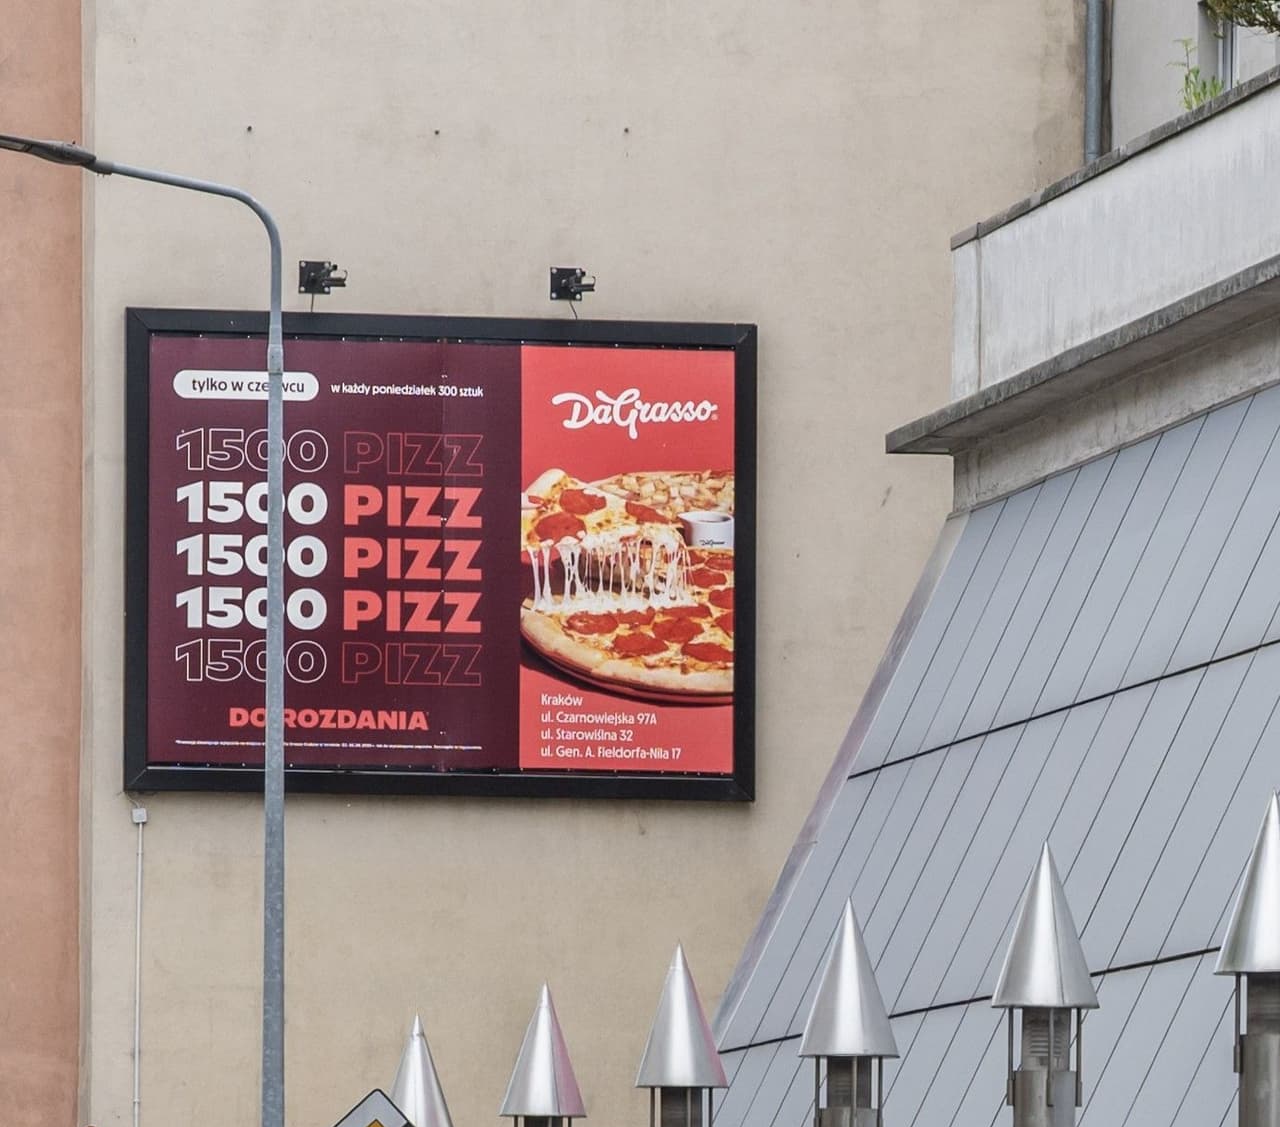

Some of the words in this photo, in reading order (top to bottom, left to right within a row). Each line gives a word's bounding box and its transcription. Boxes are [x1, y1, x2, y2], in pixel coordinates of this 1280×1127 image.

[192, 377, 227, 392] tylko
[231, 381, 244, 391] w
[247, 382, 305, 392] czewcu
[331, 384, 340, 393] w
[342, 383, 370, 395] każdy
[372, 384, 436, 396] poniedziałek
[438, 385, 457, 397] 300
[459, 386, 483, 397] sztuk
[176, 428, 329, 473] 1500
[344, 432, 483, 476] PIZZ
[176, 480, 329, 525] 1500
[344, 484, 483, 528] PIZZ
[176, 533, 328, 578] 1500
[343, 536, 482, 581] PIZZ
[176, 586, 327, 630] 1500
[343, 590, 481, 633] PIZZ
[175, 638, 327, 684] 1500
[342, 642, 482, 686] PIZZ
[541, 694, 583, 706] Kraków
[229, 708, 267, 728] DO
[284, 709, 430, 731] ROZDANIA
[541, 712, 554, 723] ul.
[556, 711, 634, 725] Czarnowiejska
[637, 713, 657, 725] 97A
[541, 729, 554, 740] ul.
[620, 730, 633, 742] 32
[541, 746, 554, 757] ul.
[556, 746, 583, 758] Gen.
[585, 747, 595, 758] A.
[671, 748, 681, 760] 17
